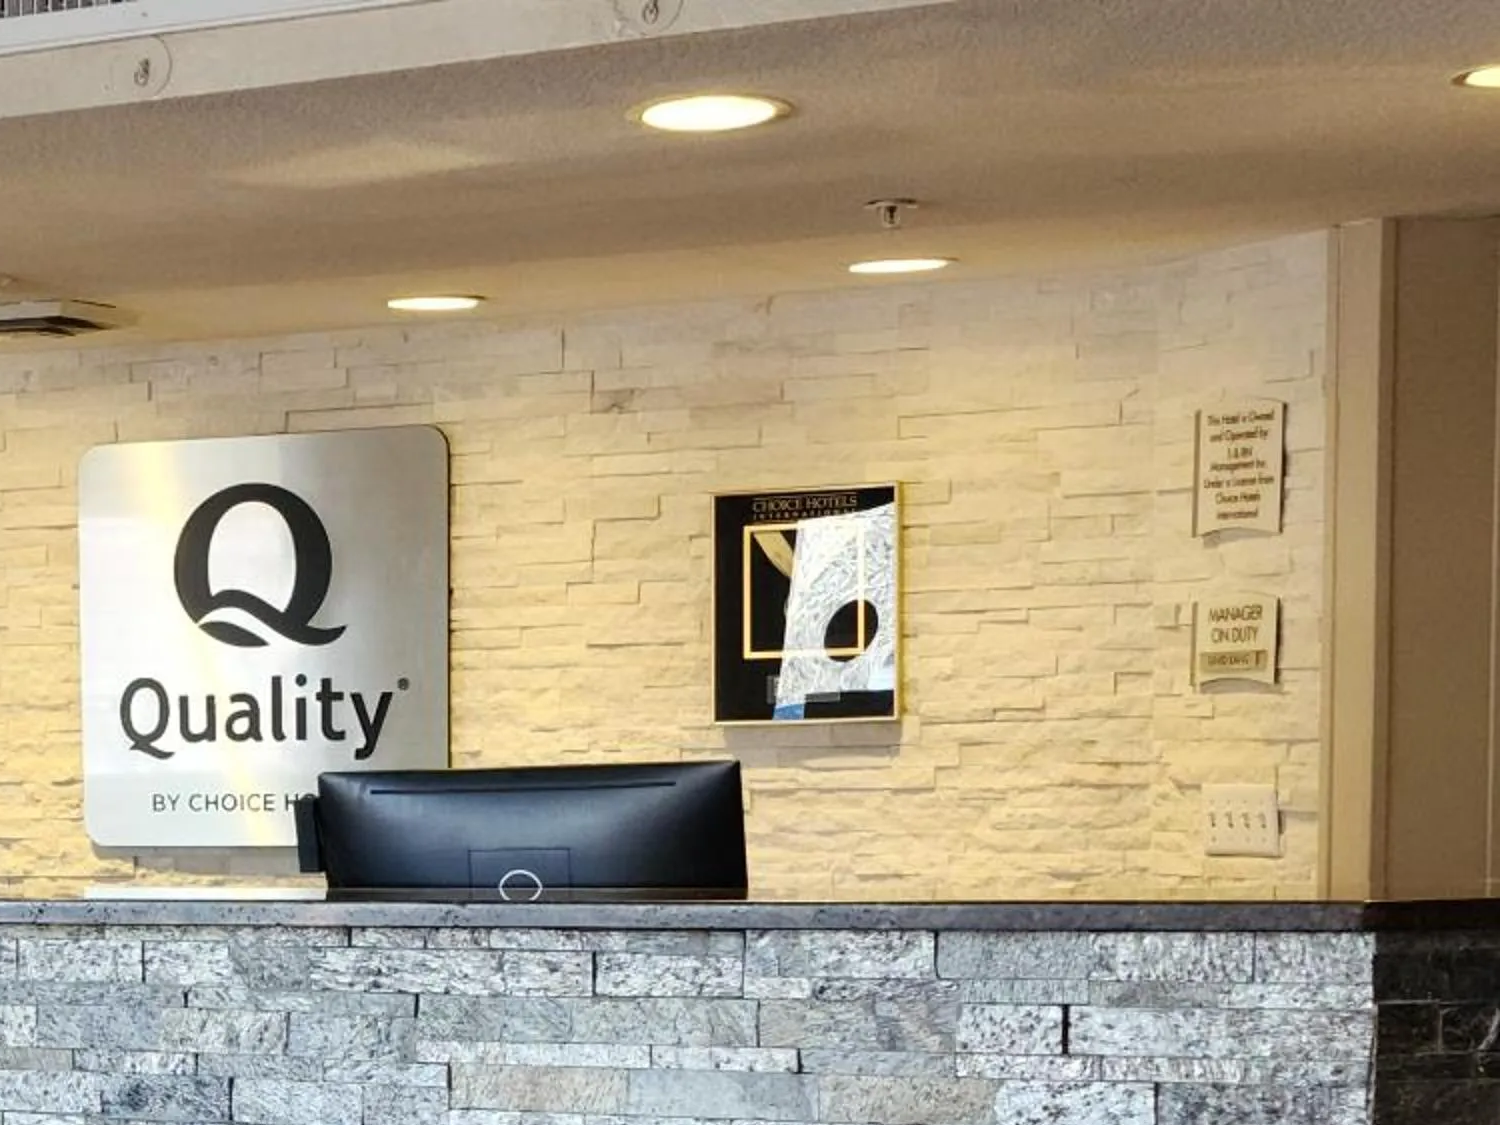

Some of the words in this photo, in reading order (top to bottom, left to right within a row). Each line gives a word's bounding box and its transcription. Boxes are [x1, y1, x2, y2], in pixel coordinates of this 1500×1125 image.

[805, 495, 857, 509] HOTELS
[174, 483, 347, 647] Q
[1208, 604, 1263, 623] MANAGER
[1211, 627, 1229, 643] ON
[1231, 625, 1258, 643] DUTY
[120, 674, 393, 760] Quality
[152, 793, 180, 812] BY
[188, 793, 276, 812] CHOICE
